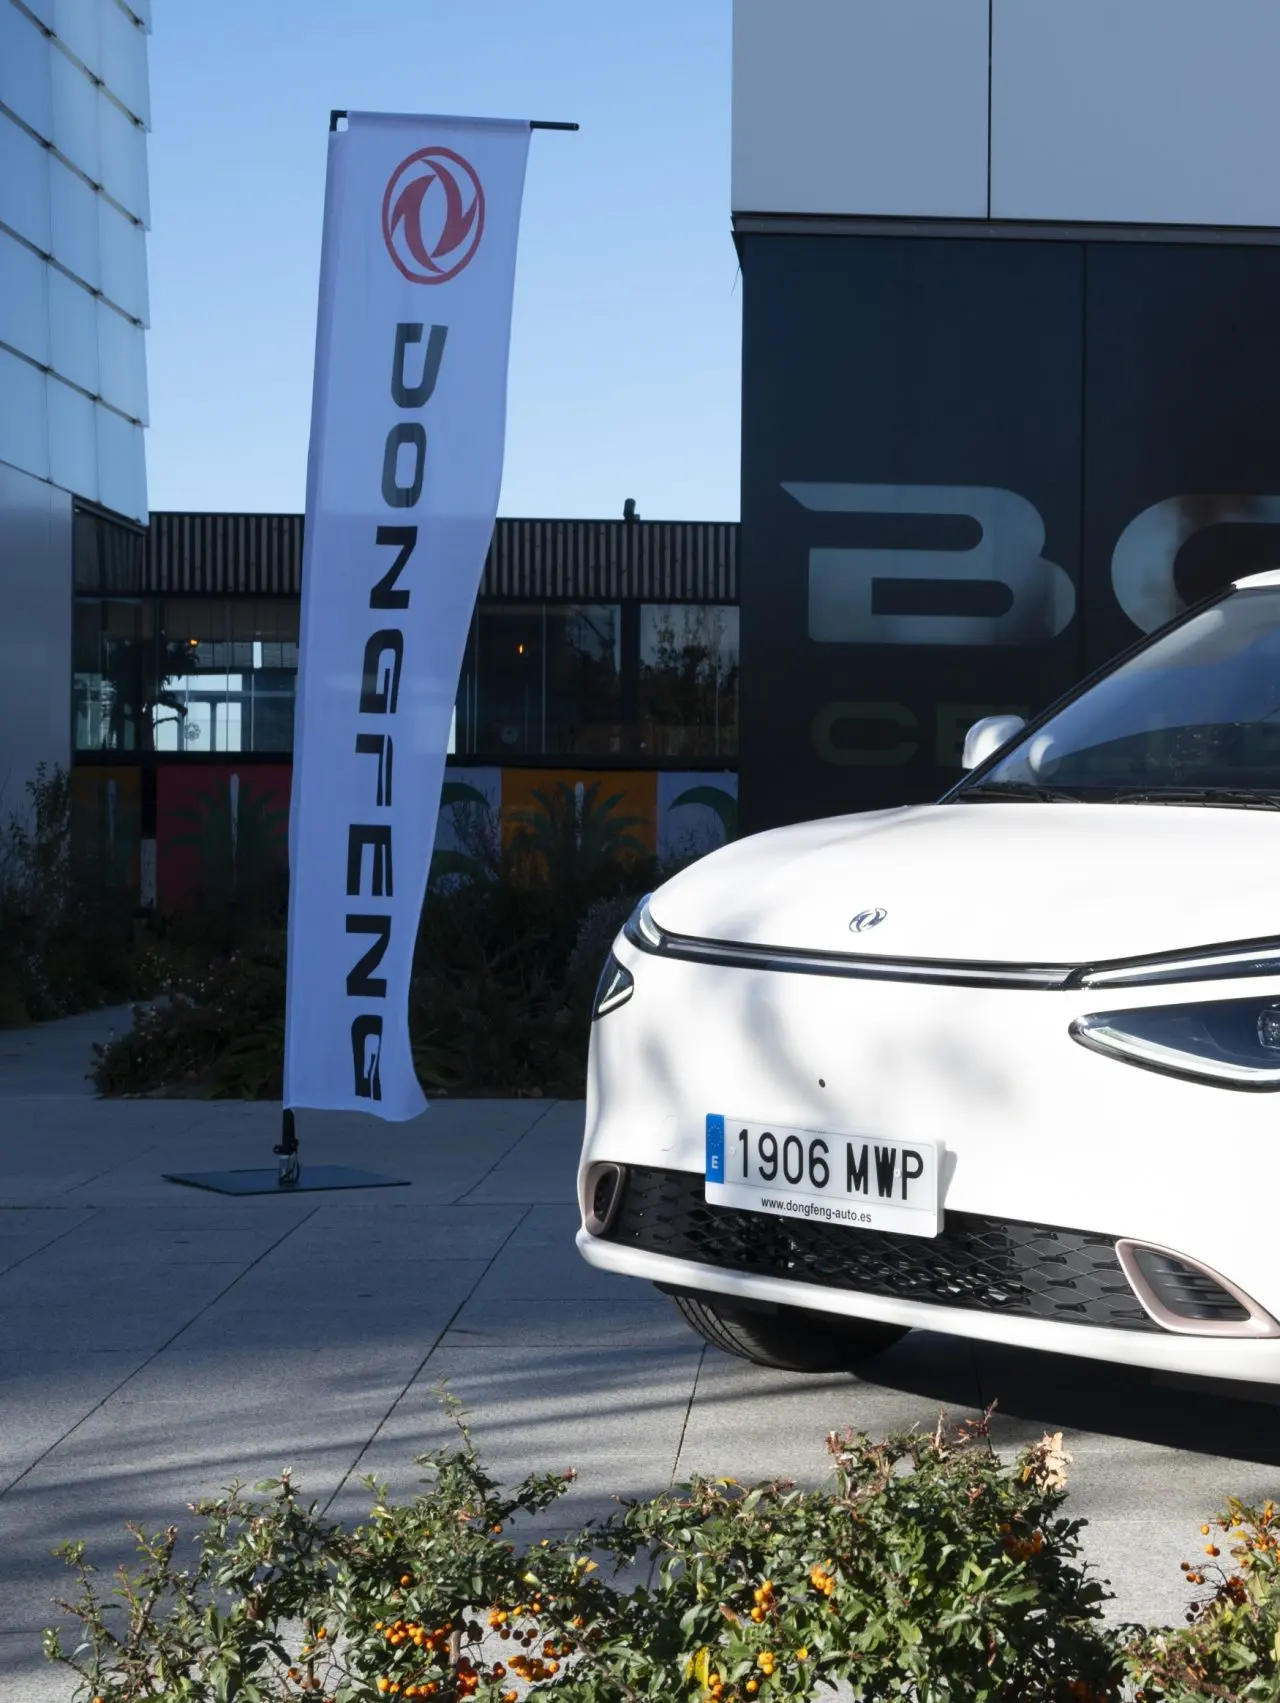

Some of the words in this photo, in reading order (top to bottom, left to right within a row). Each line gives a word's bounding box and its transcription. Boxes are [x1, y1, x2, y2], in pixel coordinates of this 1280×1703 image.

[345, 321, 449, 1102] DONGFENG
[711, 1155, 719, 1169] E
[738, 1128, 831, 1189] 1906
[846, 1141, 925, 1201] MWP
[760, 1196, 873, 1224] www.dongfeng-auto.es
